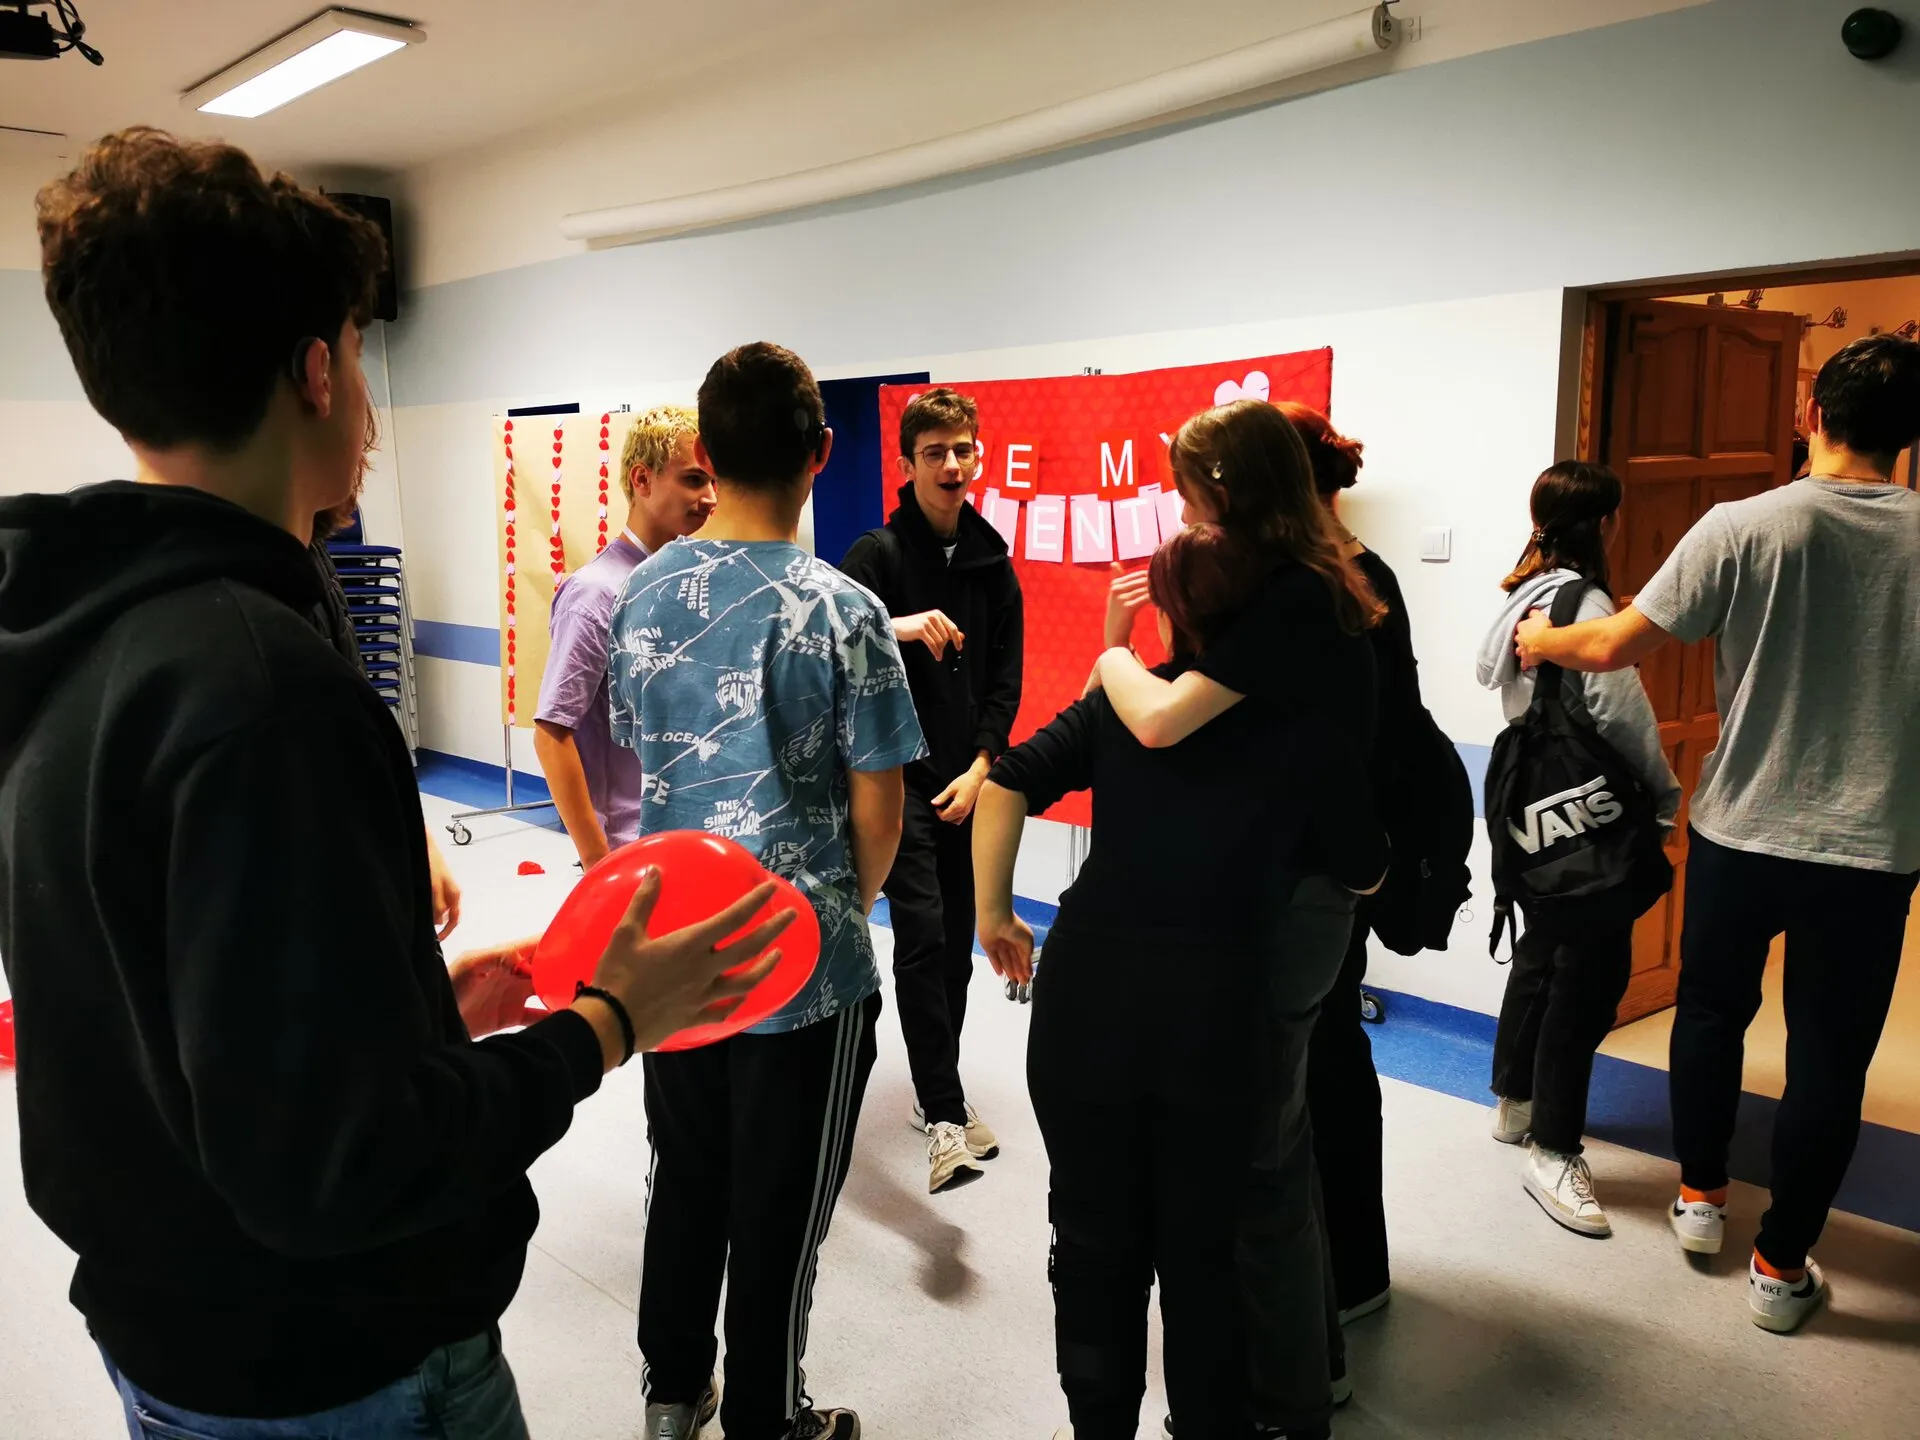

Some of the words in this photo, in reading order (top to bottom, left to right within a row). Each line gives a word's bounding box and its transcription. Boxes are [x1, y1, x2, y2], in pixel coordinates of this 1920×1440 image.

[677, 577, 690, 600] THE
[863, 679, 898, 696] LIFE
[715, 800, 739, 812] THE
[1506, 774, 1624, 854] VANS
[1692, 1209, 1713, 1219] NIKE
[1760, 1283, 1782, 1296] NIKE
